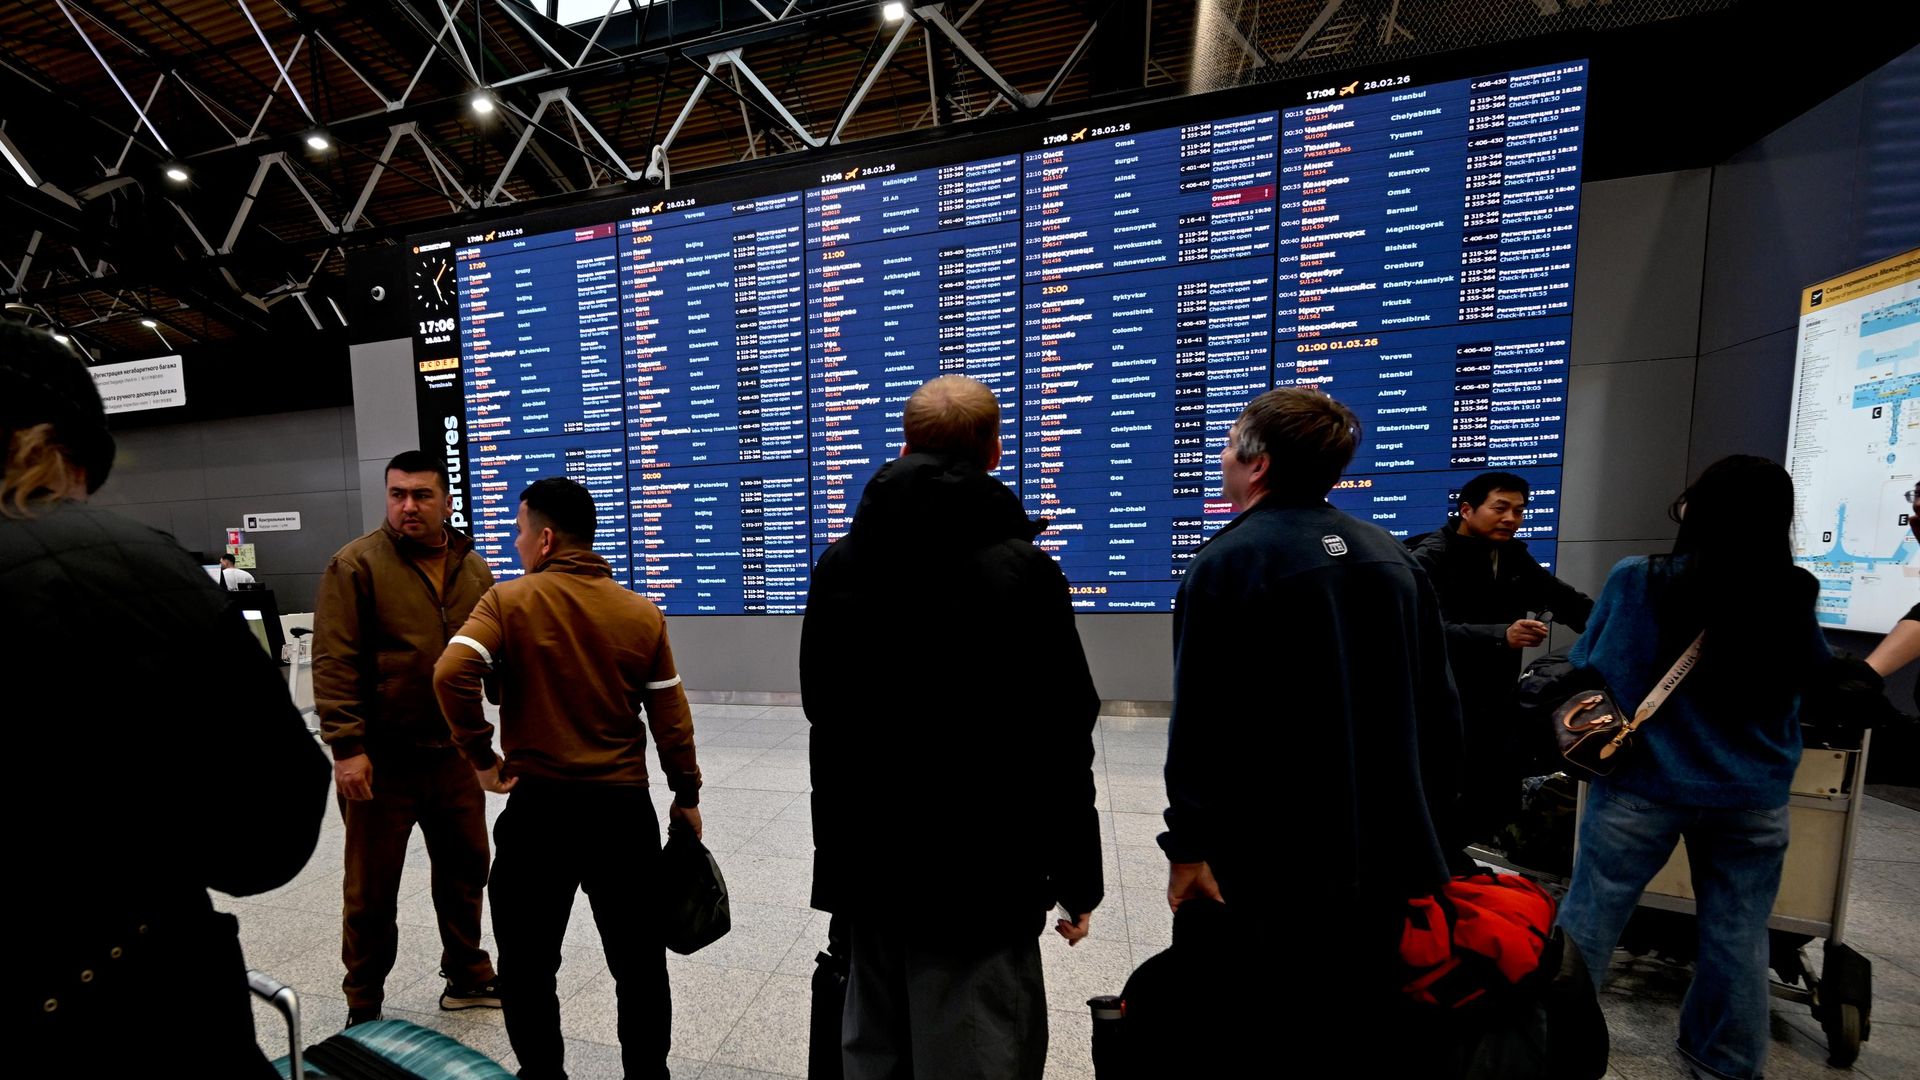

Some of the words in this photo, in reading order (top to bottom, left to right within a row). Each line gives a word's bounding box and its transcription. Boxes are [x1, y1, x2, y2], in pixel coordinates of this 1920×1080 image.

[1510, 70, 1556, 82] Регистрация
[1478, 78, 1507, 88] 406-430
[1509, 79, 1540, 88] Check-in
[1541, 75, 1561, 84] 18:15
[1306, 88, 1336, 100] 17:06
[1364, 75, 1410, 90] 28.02.26
[1392, 91, 1426, 102] Istanbul
[1285, 110, 1304, 118] 00:15
[1305, 104, 1344, 115] Стамбул
[1390, 108, 1442, 121] Chelyabinsk
[1305, 113, 1328, 122] SU2134
[1284, 128, 1304, 136] 00:30
[1304, 120, 1355, 134] Челябинск
[1043, 134, 1068, 145] 17:06
[1092, 123, 1130, 136] 28.02.26
[1304, 132, 1328, 140] SU1092
[1390, 130, 1423, 140] Tyumen
[1304, 141, 1341, 152] Тюмень
[1042, 150, 1064, 159] Омск
[1389, 150, 1414, 159] Minsk
[1115, 156, 1138, 165] Surgut
[1303, 160, 1334, 171] Минск
[821, 172, 842, 183] 17:06
[862, 164, 896, 176] 28.02.26
[1042, 166, 1069, 177] Сургут
[1388, 167, 1430, 178] Kemerovo
[882, 175, 917, 186] Kaliningrad
[1114, 174, 1136, 182] Minsk
[1303, 177, 1350, 189] Кемерово
[1042, 183, 1068, 193] Минск
[1387, 188, 1411, 196] Omsk
[1042, 201, 1064, 210] Мале
[1211, 200, 1240, 208] Cancelled
[1302, 198, 1327, 207] Омск
[631, 206, 650, 216] 17:06
[883, 208, 919, 218] Krasnoyarsk
[1114, 208, 1139, 216] Muscat
[1386, 205, 1418, 215] Barnaul
[1042, 216, 1071, 226] Маскат
[1301, 214, 1340, 225] Барнаул
[883, 225, 910, 234] Belgrade
[1114, 223, 1157, 233] Krasnoyarsk
[1386, 221, 1444, 233] Magnitogorsk
[1042, 231, 1088, 243] Красноярск
[1300, 229, 1366, 243] Магнитогорск
[1114, 239, 1162, 250] Novokuznetsk
[1385, 243, 1417, 252] Bishkek
[822, 250, 845, 260] 21:00
[1042, 247, 1094, 259] Новокузнецк
[1300, 251, 1336, 261] Бишкек
[469, 261, 486, 270] 17:00
[883, 256, 912, 265] Shenzhen
[1113, 256, 1166, 267] Nizhnevartovsk
[1384, 261, 1424, 270] Orenburg
[1042, 262, 1104, 276] Нижневартовск
[1299, 268, 1344, 279] Оренбург
[883, 271, 920, 280] Arkhangelsk
[1383, 276, 1454, 288] Khanty-Mansiysk
[1042, 285, 1068, 295] 23:00
[1298, 283, 1376, 297] Ханты-Мансийск
[1112, 292, 1147, 301] Syktyvkar
[1382, 298, 1412, 307] Irkutsk
[1112, 308, 1154, 317] Novosibirsk
[1298, 305, 1335, 315] Иркутск
[1381, 315, 1430, 324] Novosibirsk
[420, 318, 455, 334] 17:06
[1298, 321, 1358, 332] Новосибирск
[1297, 343, 1328, 352] 01:00
[1329, 338, 1378, 350] 01.03.26
[1112, 358, 1156, 367] Ekaterinburg
[1296, 359, 1329, 367] Ереван
[1379, 370, 1413, 379] Istanbul
[885, 380, 923, 388] Ekaterinburg
[1111, 376, 1150, 384] Guangzhou
[1296, 376, 1333, 385] Стамбул
[1111, 392, 1156, 400] Ekaterinburg
[1377, 406, 1427, 414] Krasnoyarsk
[1377, 424, 1430, 432] Ekaterinburg
[1332, 480, 1372, 488] .03.26
